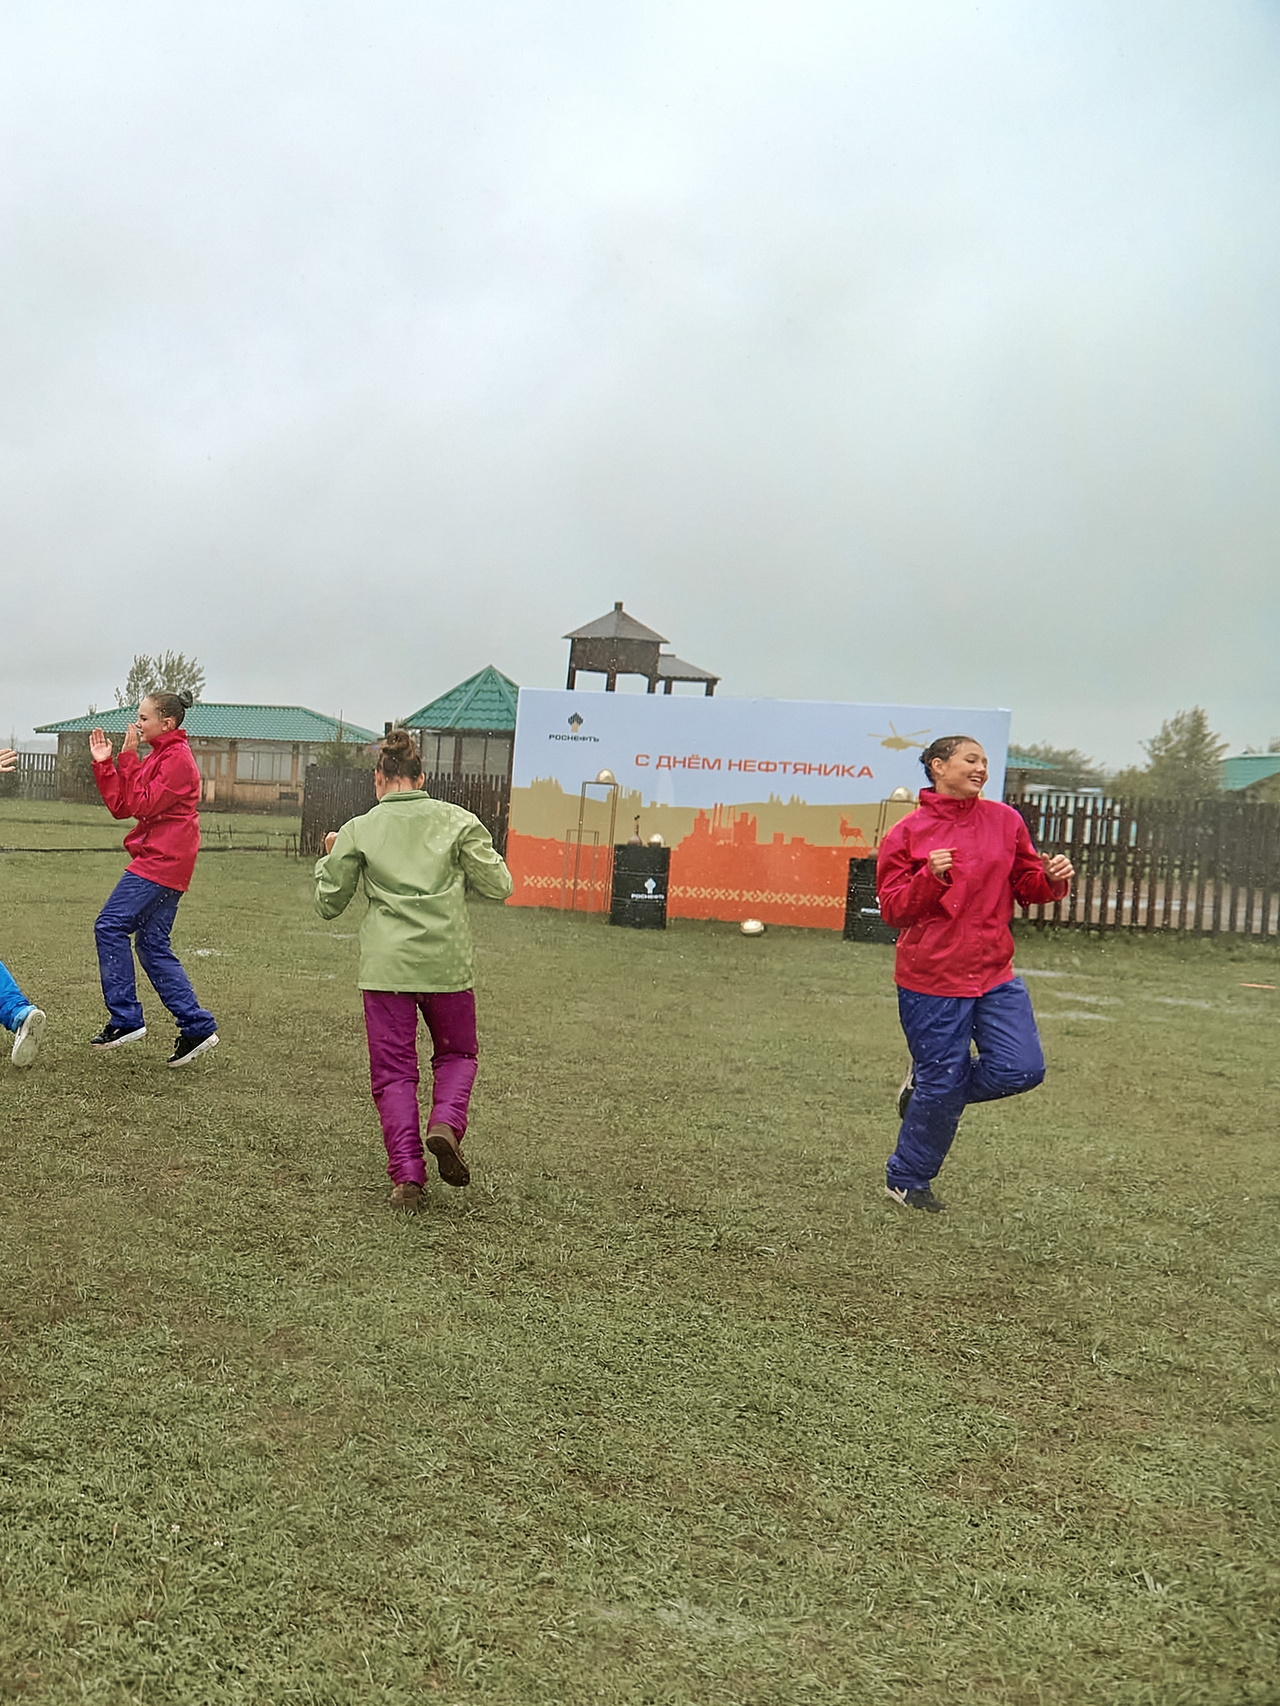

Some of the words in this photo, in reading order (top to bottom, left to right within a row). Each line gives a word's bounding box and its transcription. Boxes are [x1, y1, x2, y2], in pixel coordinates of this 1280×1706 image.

[548, 734, 600, 743] РОСНЕФТЬ
[635, 754, 650, 767] С
[656, 754, 721, 771] ДНЁМ
[728, 758, 874, 779] НЕФТЯНИКА
